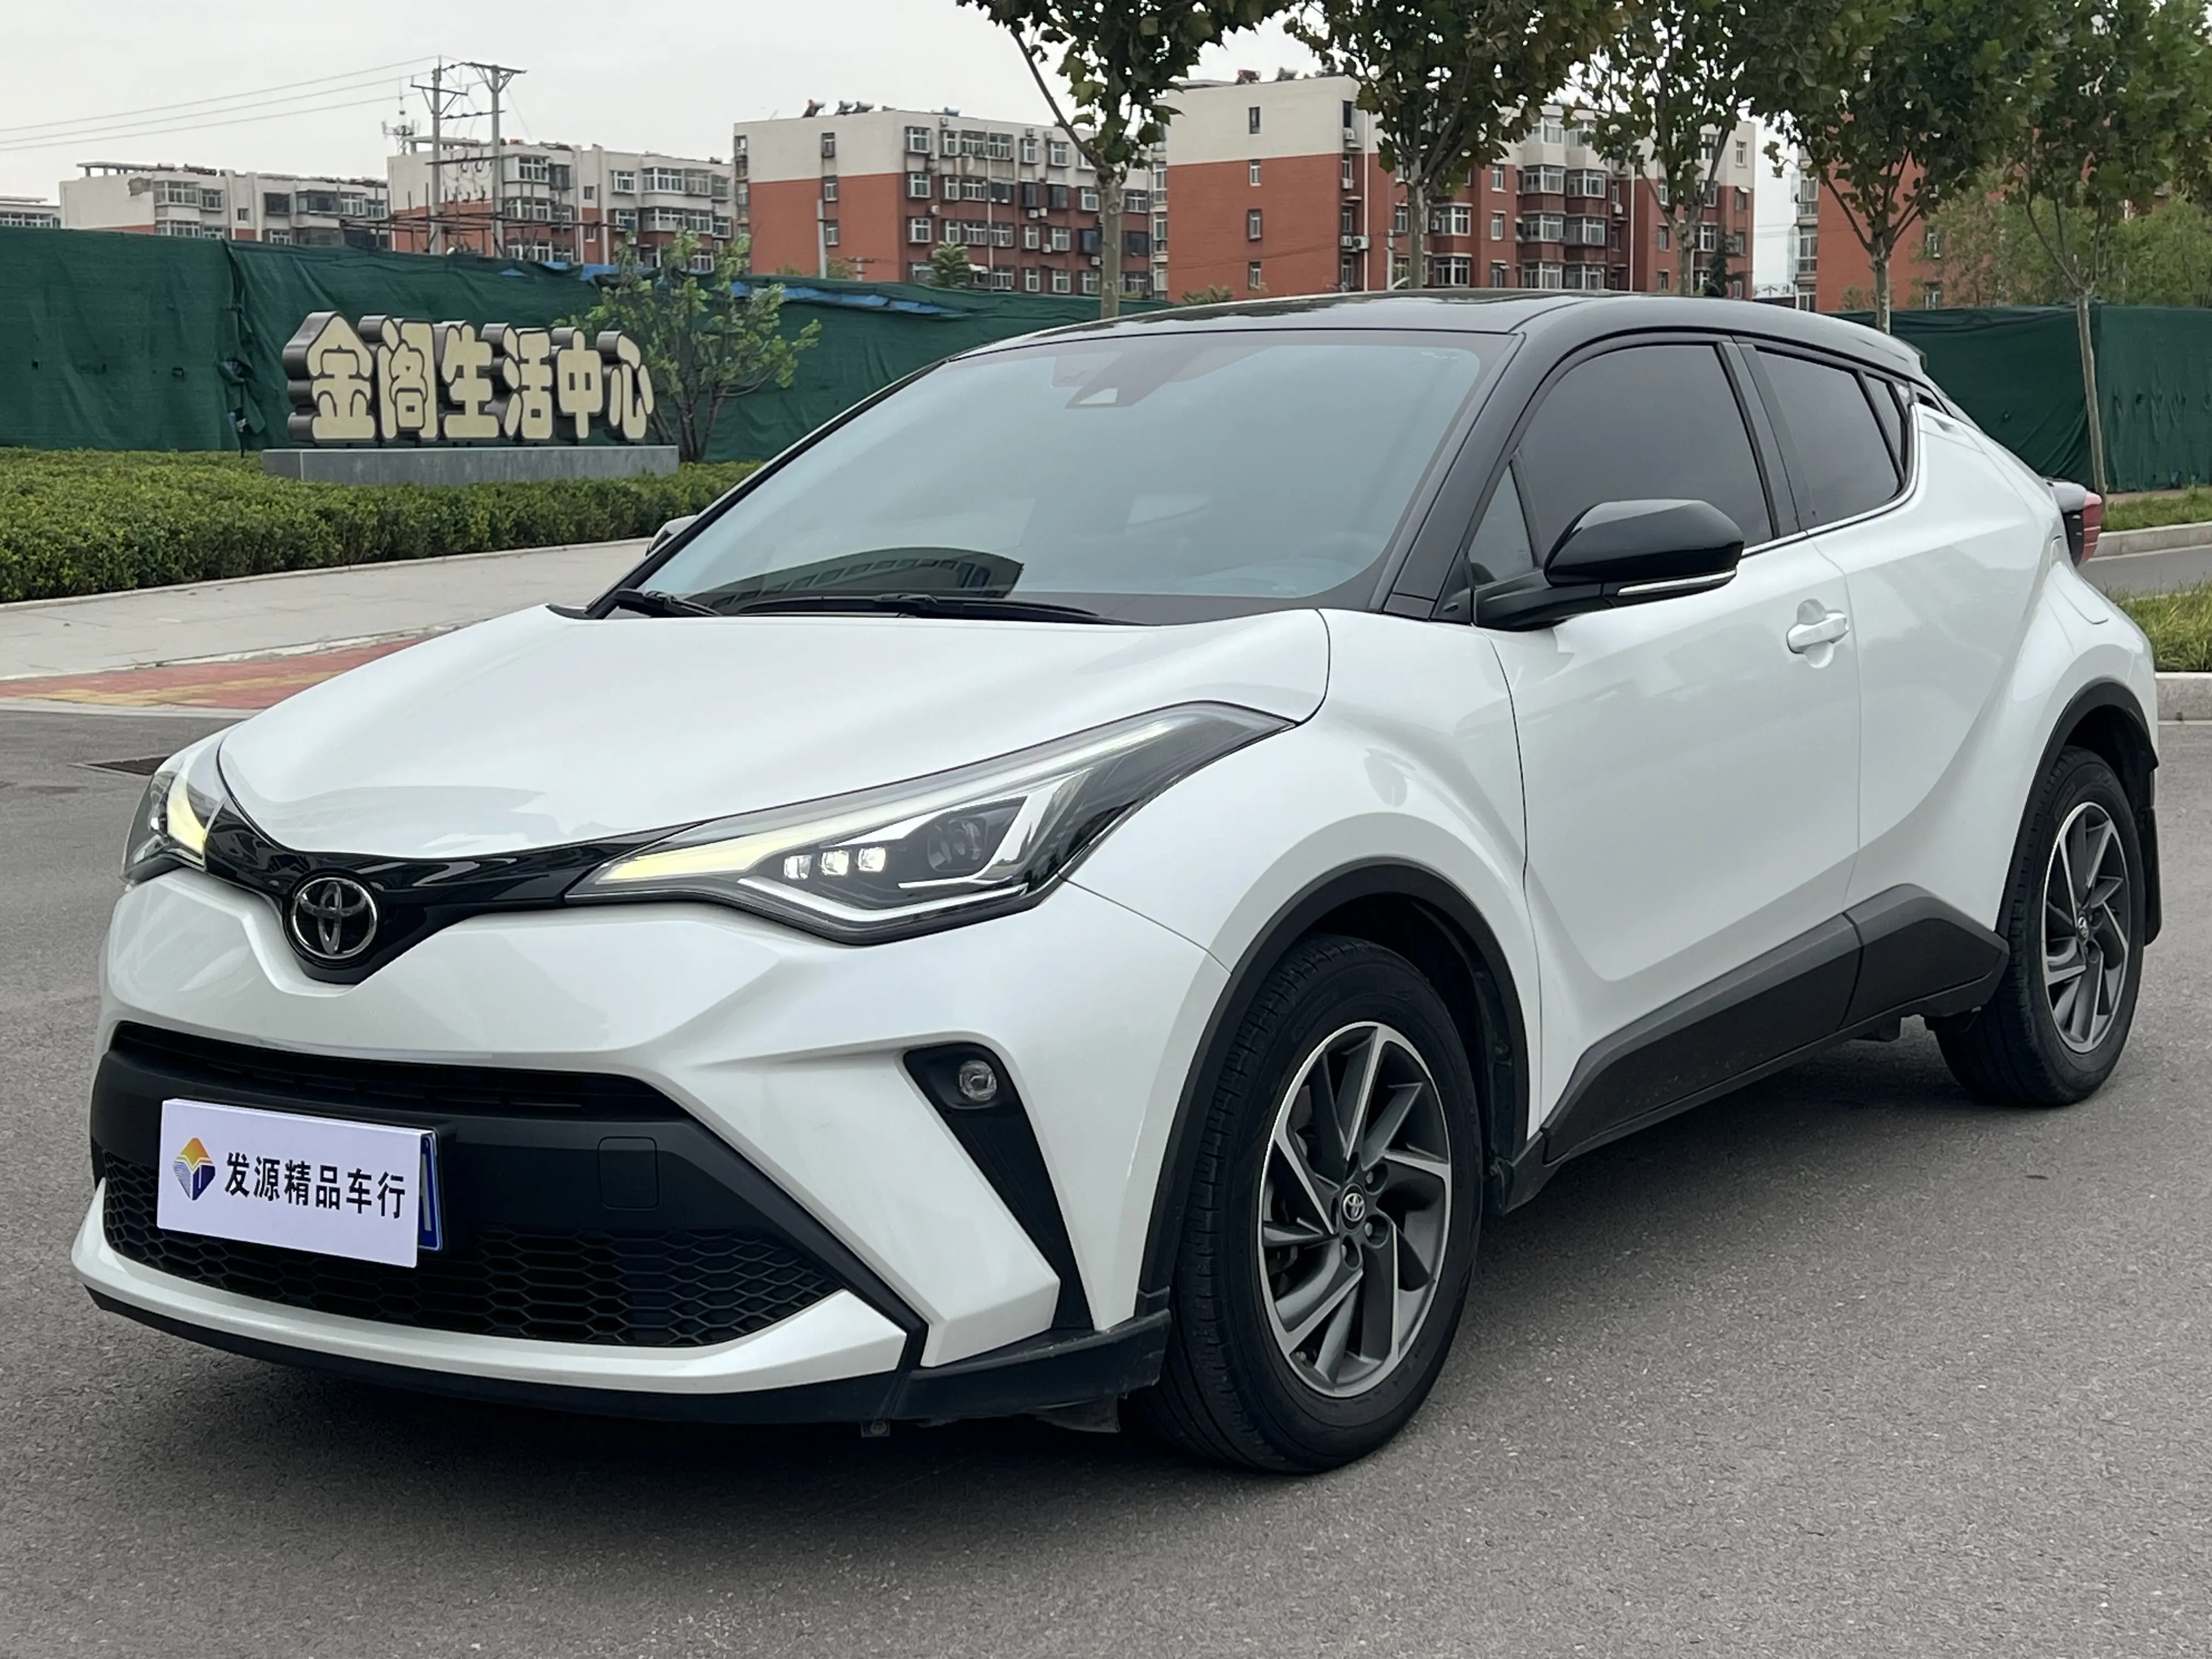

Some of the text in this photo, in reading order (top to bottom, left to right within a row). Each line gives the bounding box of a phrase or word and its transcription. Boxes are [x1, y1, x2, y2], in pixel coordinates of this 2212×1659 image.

[305, 313, 654, 440] 金阁生活中心
[224, 1152, 405, 1219] 发源精品车行
